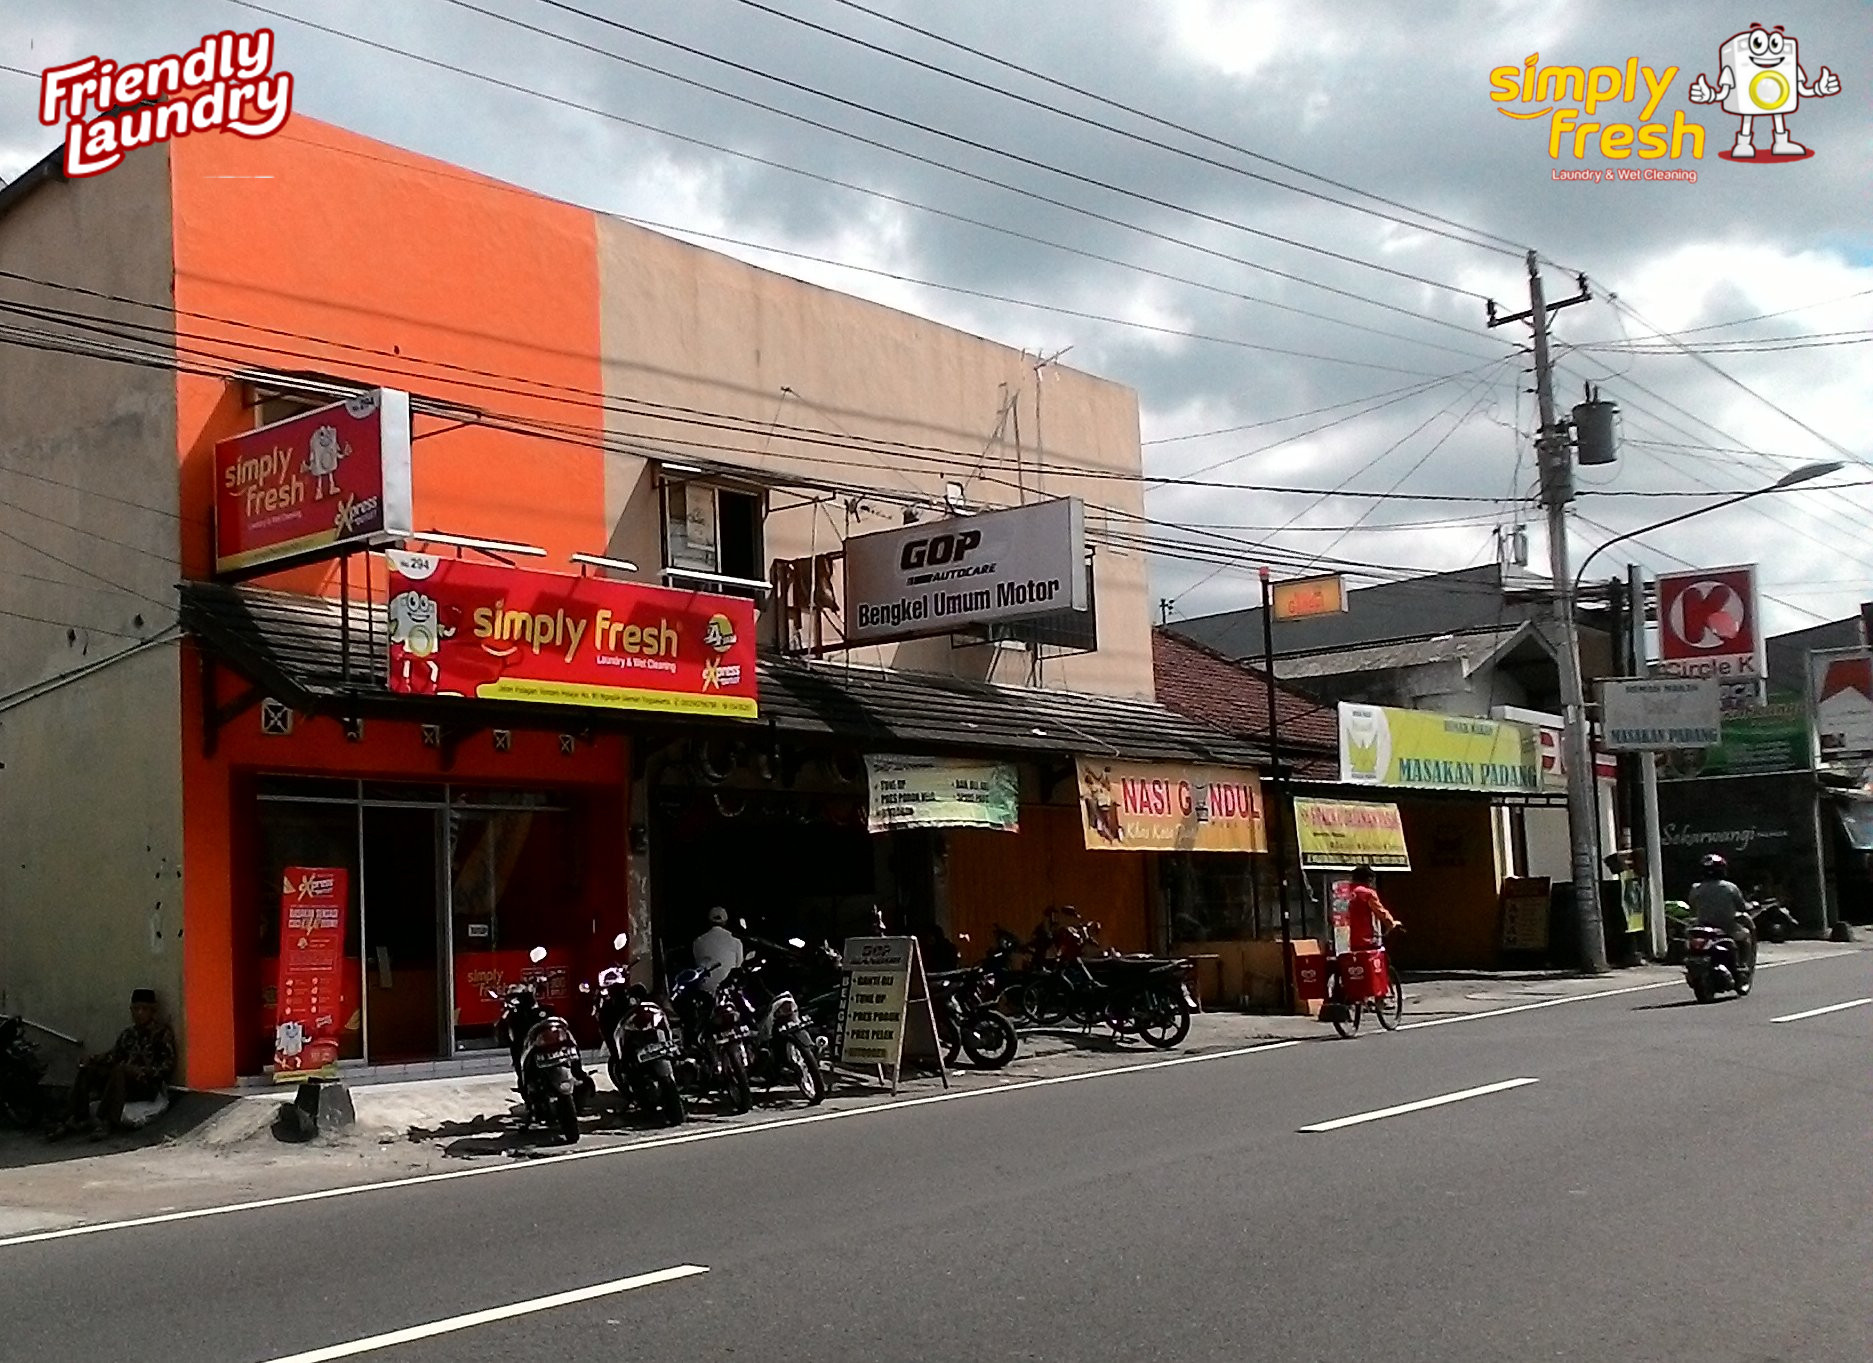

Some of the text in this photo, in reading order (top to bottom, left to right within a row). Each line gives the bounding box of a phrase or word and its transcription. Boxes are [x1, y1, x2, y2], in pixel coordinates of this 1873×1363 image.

[225, 446, 293, 489] simply
[246, 474, 305, 517] fresh
[410, 557, 430, 570] 294
[901, 530, 982, 570] GOP
[931, 562, 997, 582] AUTOCARE
[858, 579, 1060, 628] Bengkel Umum Motor
[473, 599, 678, 663] simply fresh
[597, 655, 627, 668] Laundry
[647, 660, 677, 675] Cleaning
[1667, 656, 1754, 679] Circle K
[1399, 758, 1538, 788] MASAKAN PADANG
[1121, 777, 1172, 815] NASI
[1178, 781, 1261, 819] GNDUL
